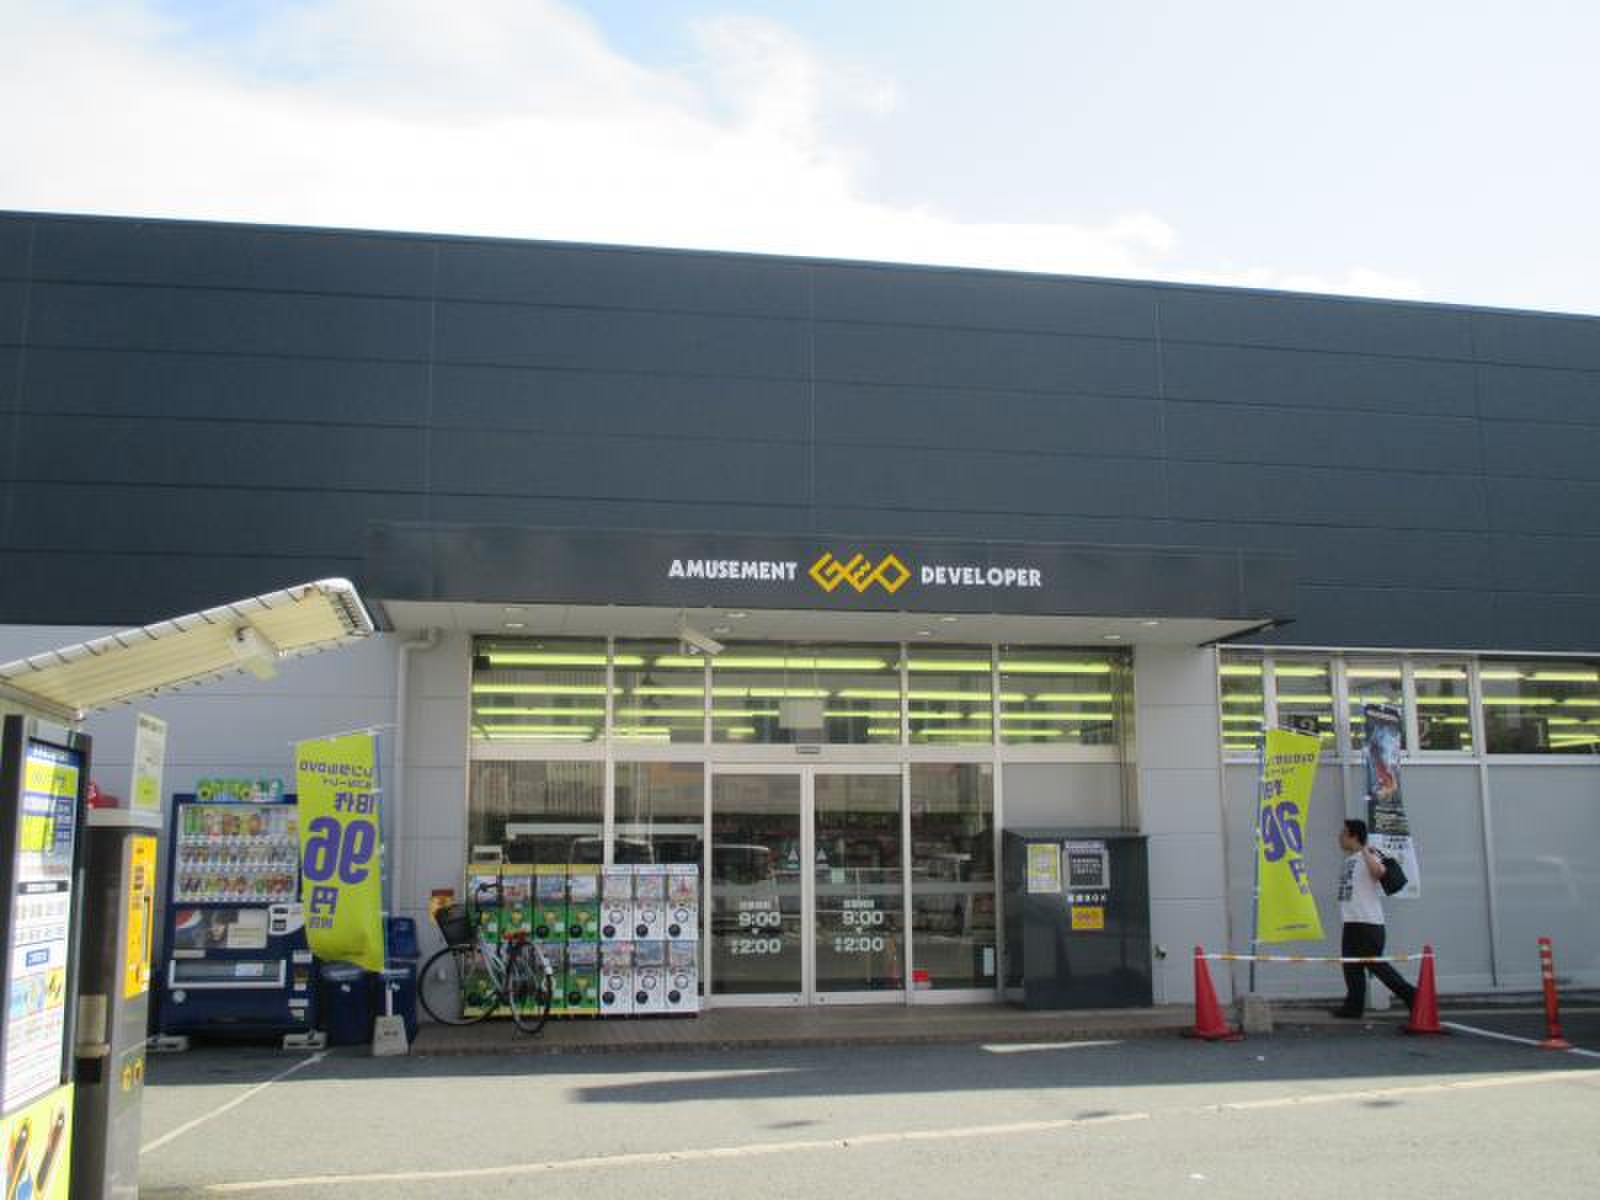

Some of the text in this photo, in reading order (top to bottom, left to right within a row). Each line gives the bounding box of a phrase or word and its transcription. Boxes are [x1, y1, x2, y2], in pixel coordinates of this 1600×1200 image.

[668, 559, 797, 581] AMUSEMENT
[921, 565, 1041, 587] DEVELOPER
[1262, 801, 1303, 863] 96
[738, 911, 782, 926] 9:00
[842, 911, 884, 926] 9:00
